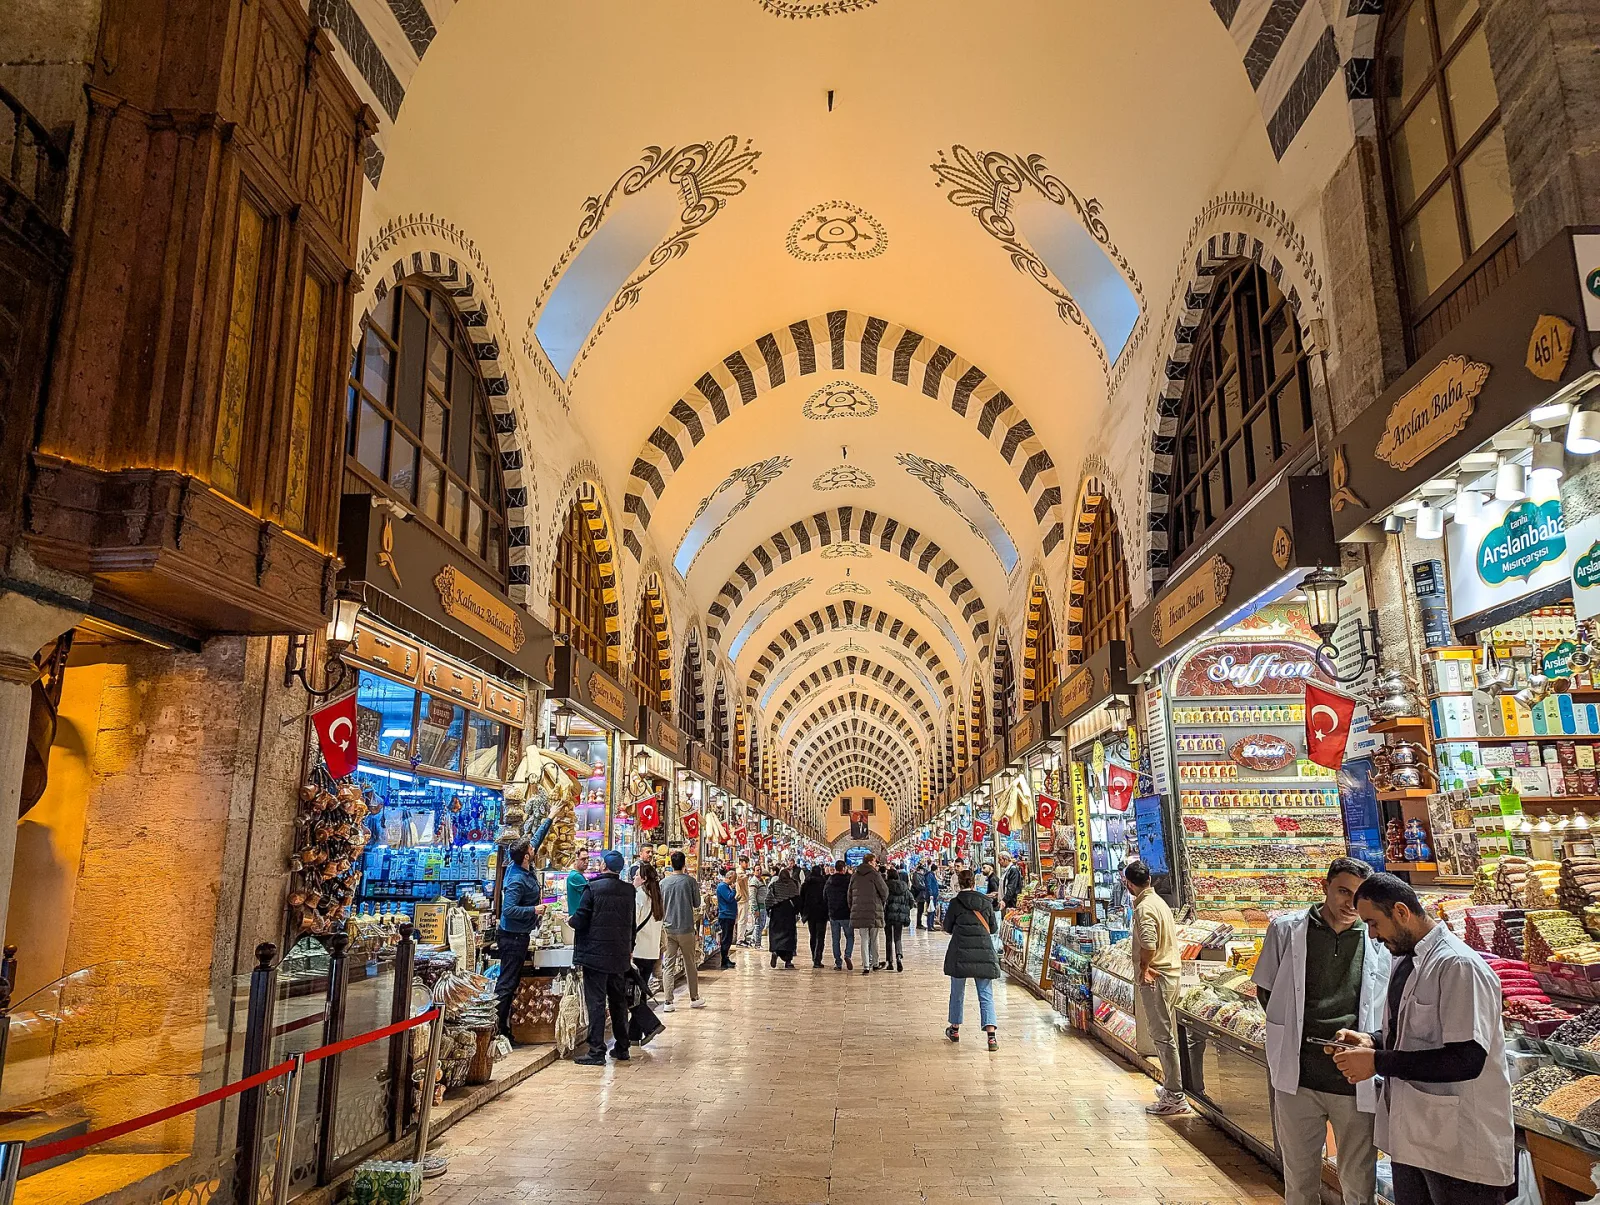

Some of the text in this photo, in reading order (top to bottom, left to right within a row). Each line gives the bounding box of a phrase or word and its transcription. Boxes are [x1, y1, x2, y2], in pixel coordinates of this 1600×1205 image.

[1534, 324, 1563, 368] 46/1
[1392, 377, 1464, 451] Arslan Baba
[1482, 514, 1566, 567] Arslanbaba
[1510, 514, 1528, 530] tarihi
[1275, 537, 1286, 559] 46
[455, 588, 512, 638] Kalmaz Baharat
[1187, 585, 1205, 614] Baba
[1207, 653, 1314, 688] Saffron
